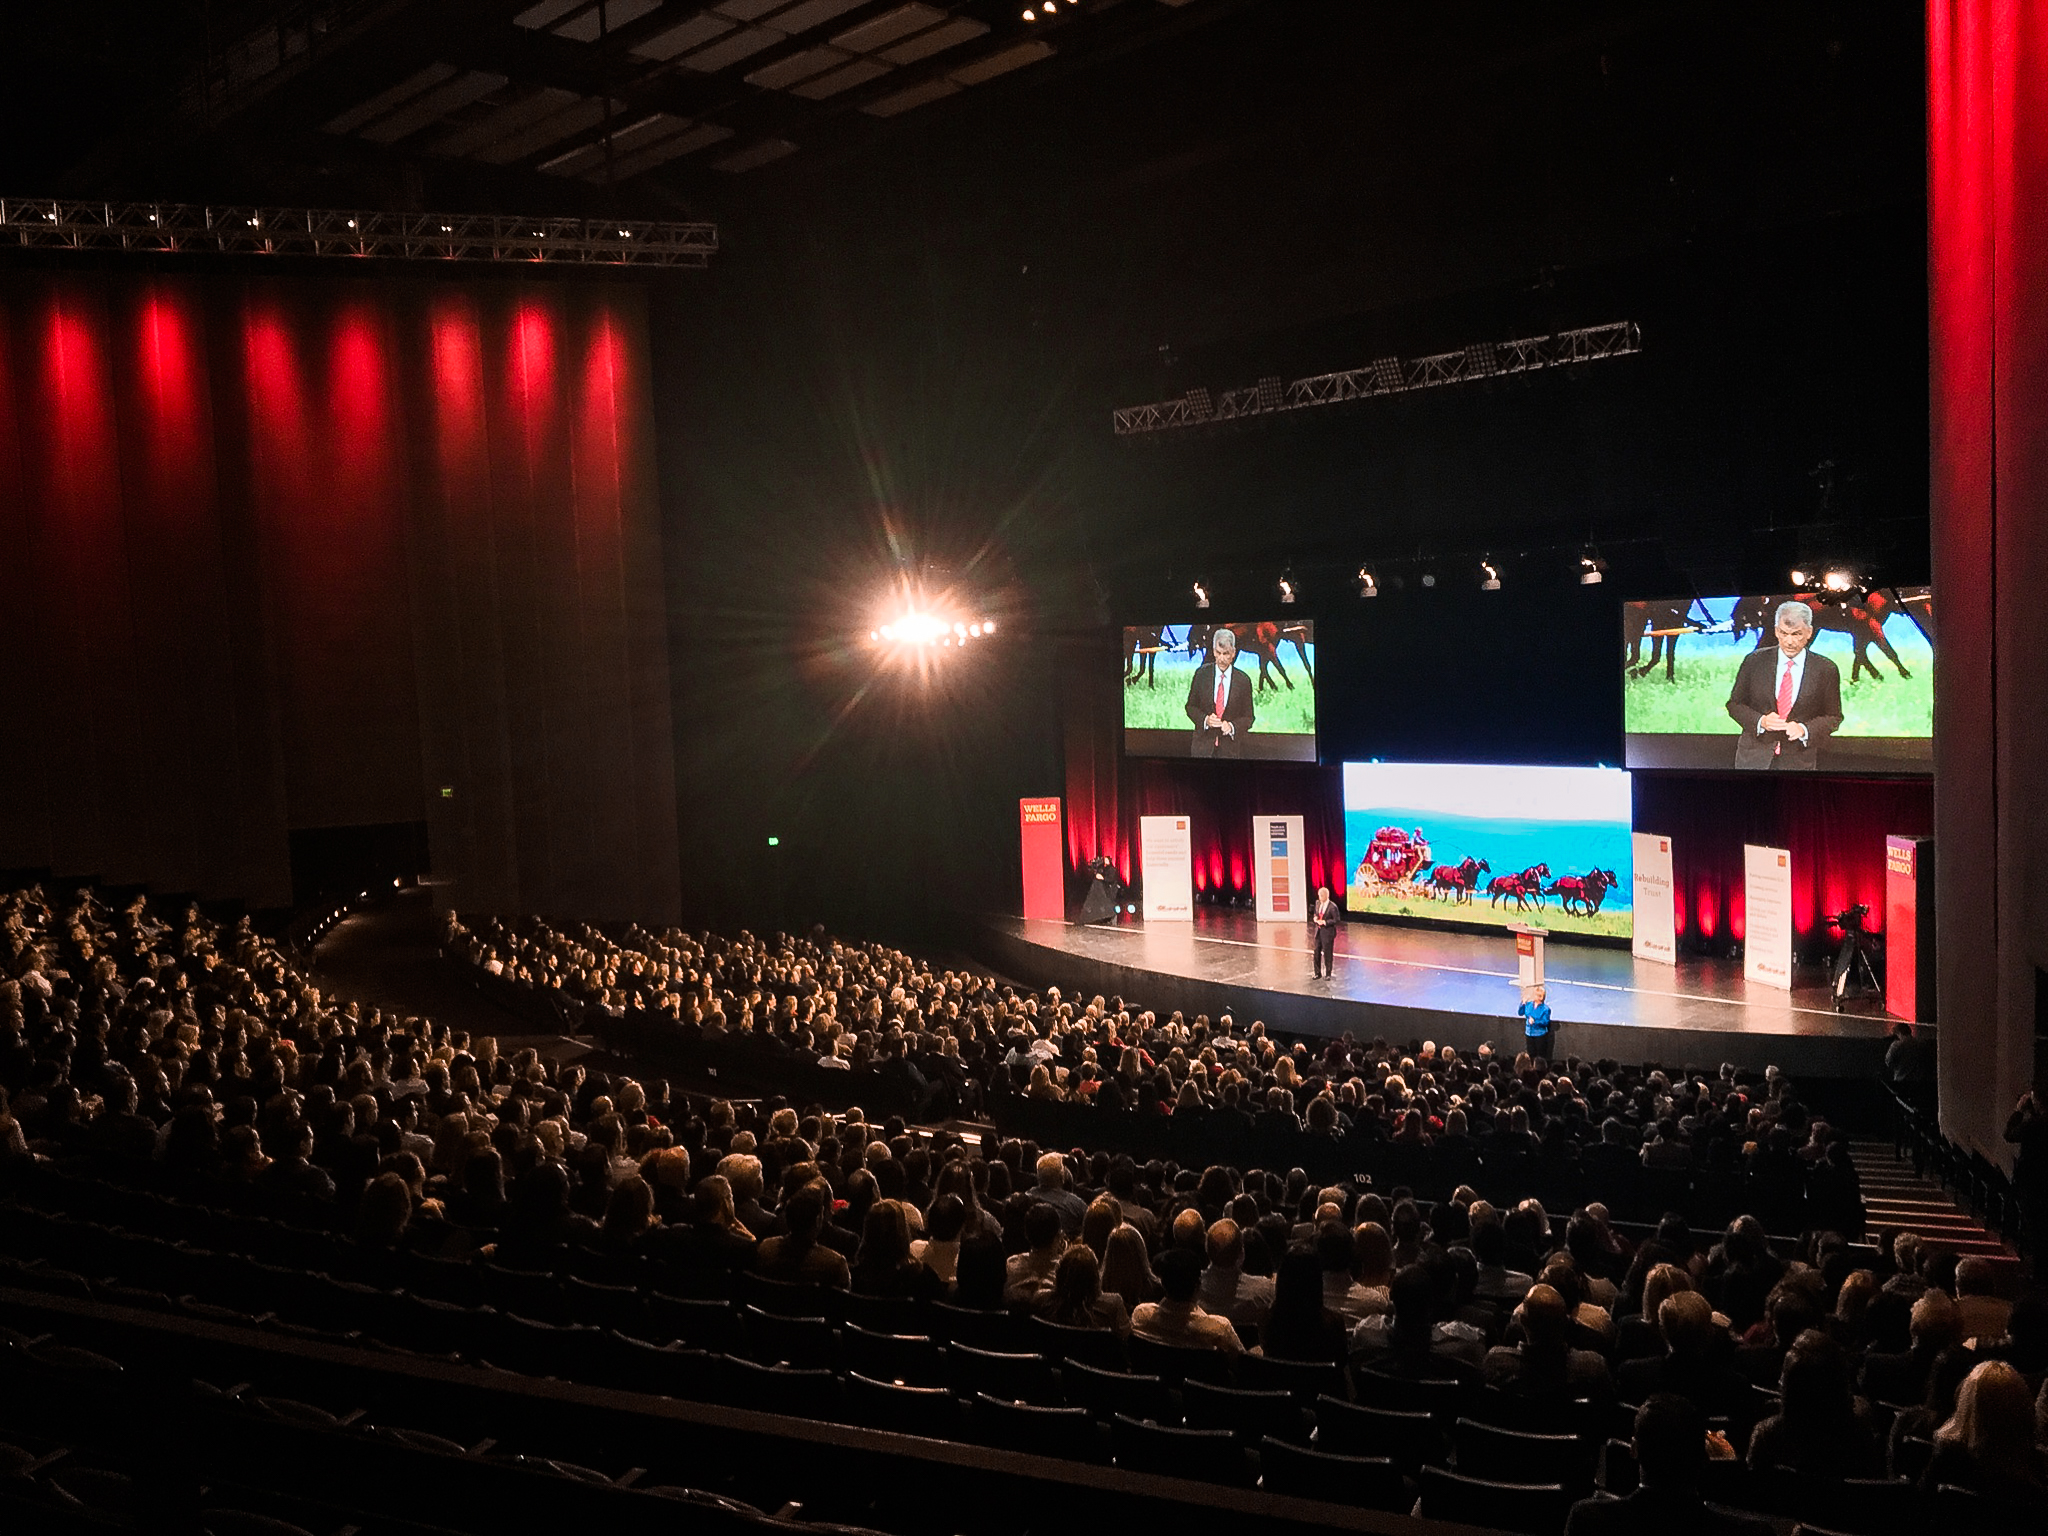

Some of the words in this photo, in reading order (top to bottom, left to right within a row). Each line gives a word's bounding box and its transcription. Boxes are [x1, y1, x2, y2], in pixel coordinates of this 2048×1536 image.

[1024, 804, 1056, 813] WELLS
[1024, 813, 1056, 822] FARGO
[1887, 845, 1911, 861] WELLS
[1887, 859, 1911, 875] FARGO
[1634, 873, 1670, 888] Rebuilding
[1643, 887, 1661, 898] Trust
[1353, 1173, 1372, 1184] 102
